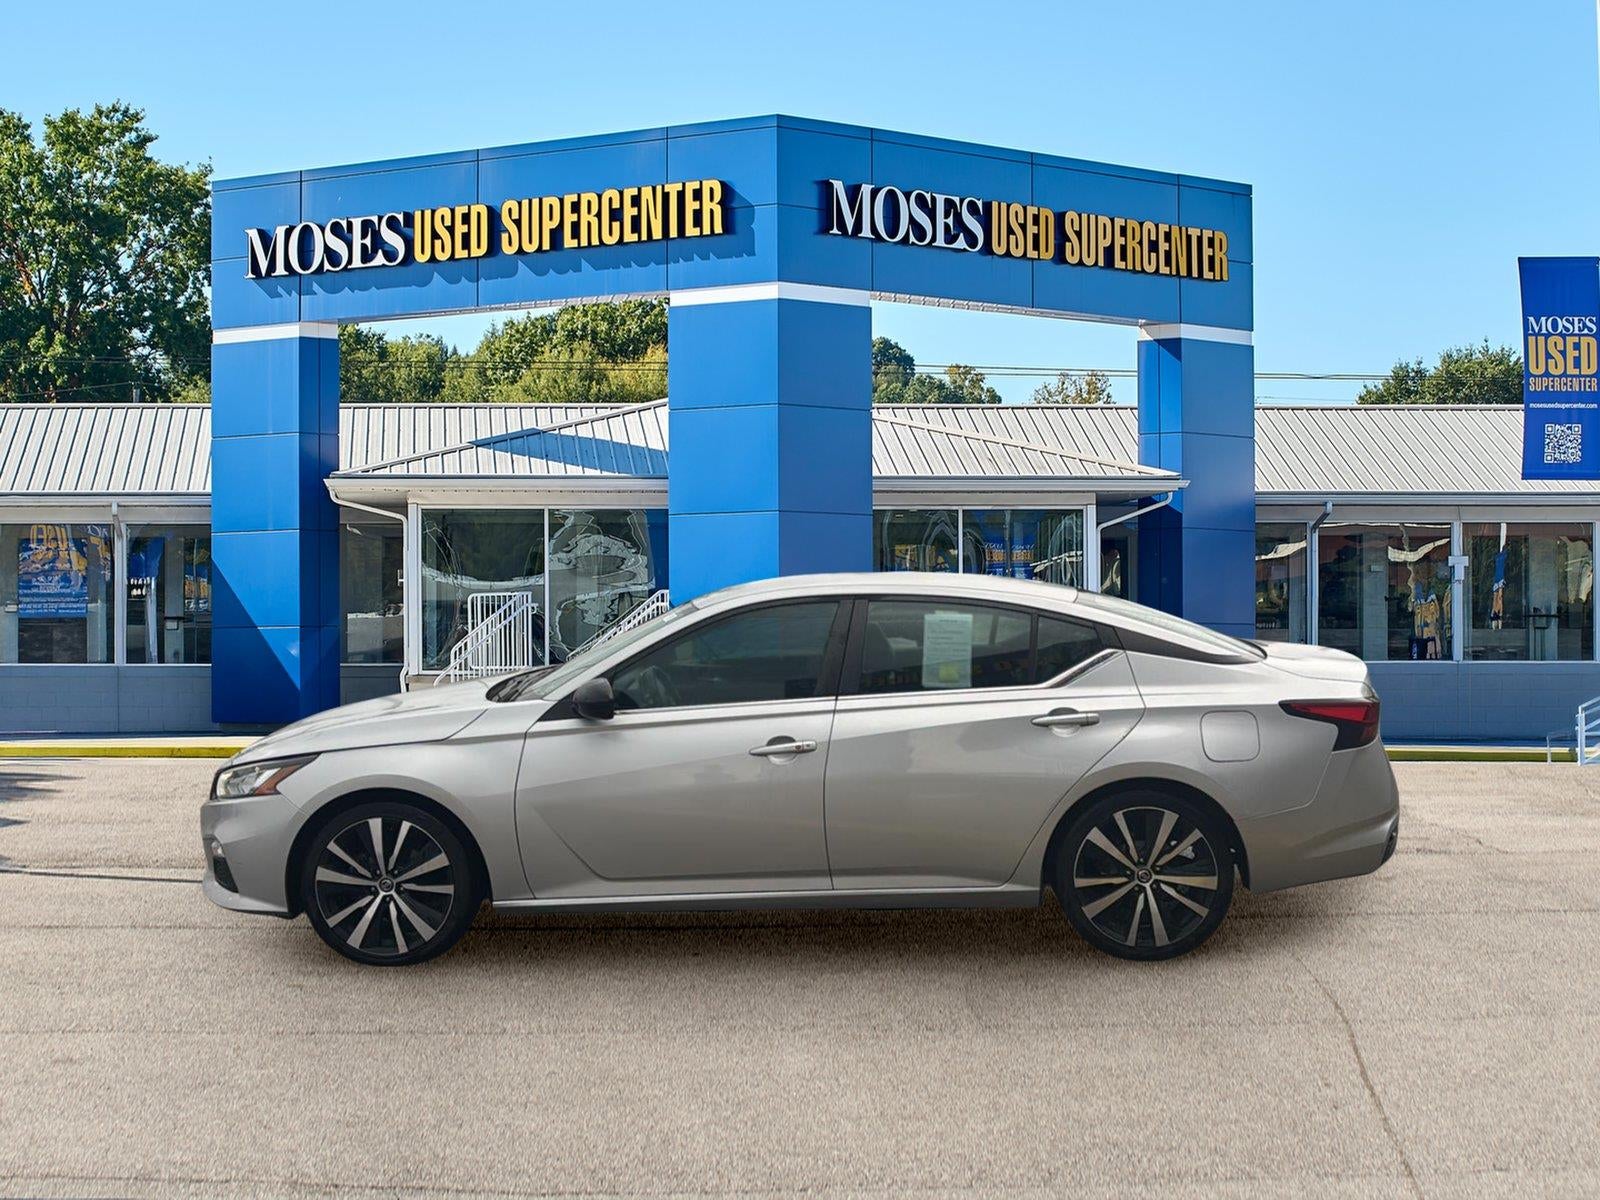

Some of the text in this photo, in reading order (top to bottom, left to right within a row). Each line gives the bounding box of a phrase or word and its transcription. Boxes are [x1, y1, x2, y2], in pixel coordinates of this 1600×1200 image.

[245, 179, 724, 280] MOSES USED SUPERCENTER
[829, 179, 1230, 281] MOSES USED SUPERCENTER
[1528, 316, 1597, 335] MOSES
[1528, 335, 1598, 375] USED
[1529, 377, 1598, 392] SUPERCENTER
[1529, 402, 1598, 410] mosesusedsupercenter.com
